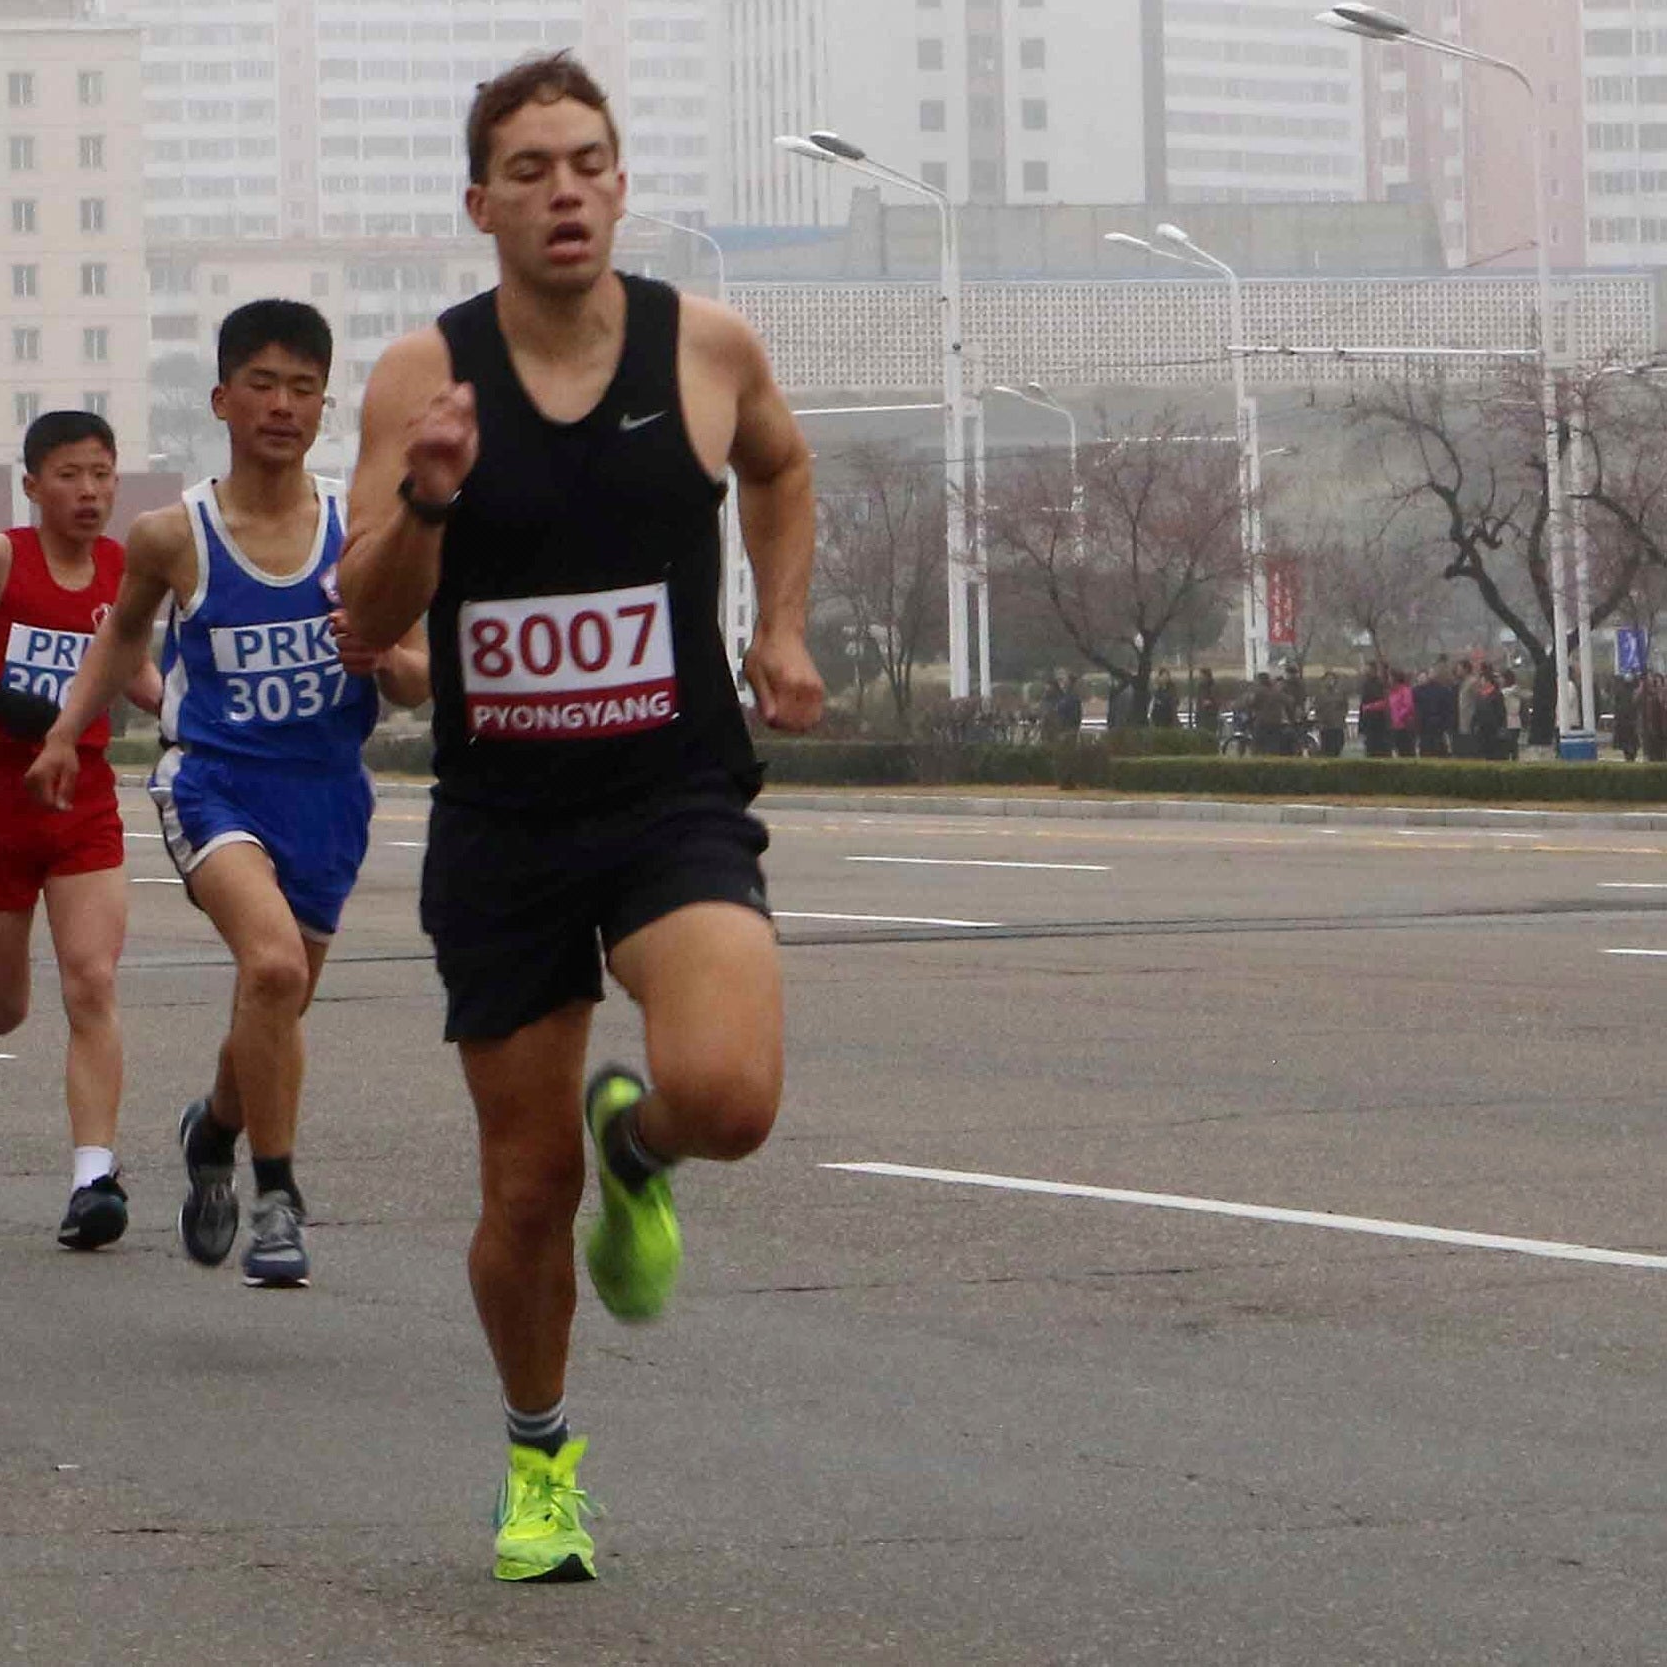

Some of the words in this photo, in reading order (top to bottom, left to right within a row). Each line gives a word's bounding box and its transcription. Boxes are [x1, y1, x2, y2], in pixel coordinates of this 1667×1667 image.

[27, 630, 89, 668] PR
[234, 622, 340, 669] PRK
[471, 603, 657, 678] 8007
[227, 663, 347, 722] 3037
[472, 691, 671, 731] PYONGYANG
